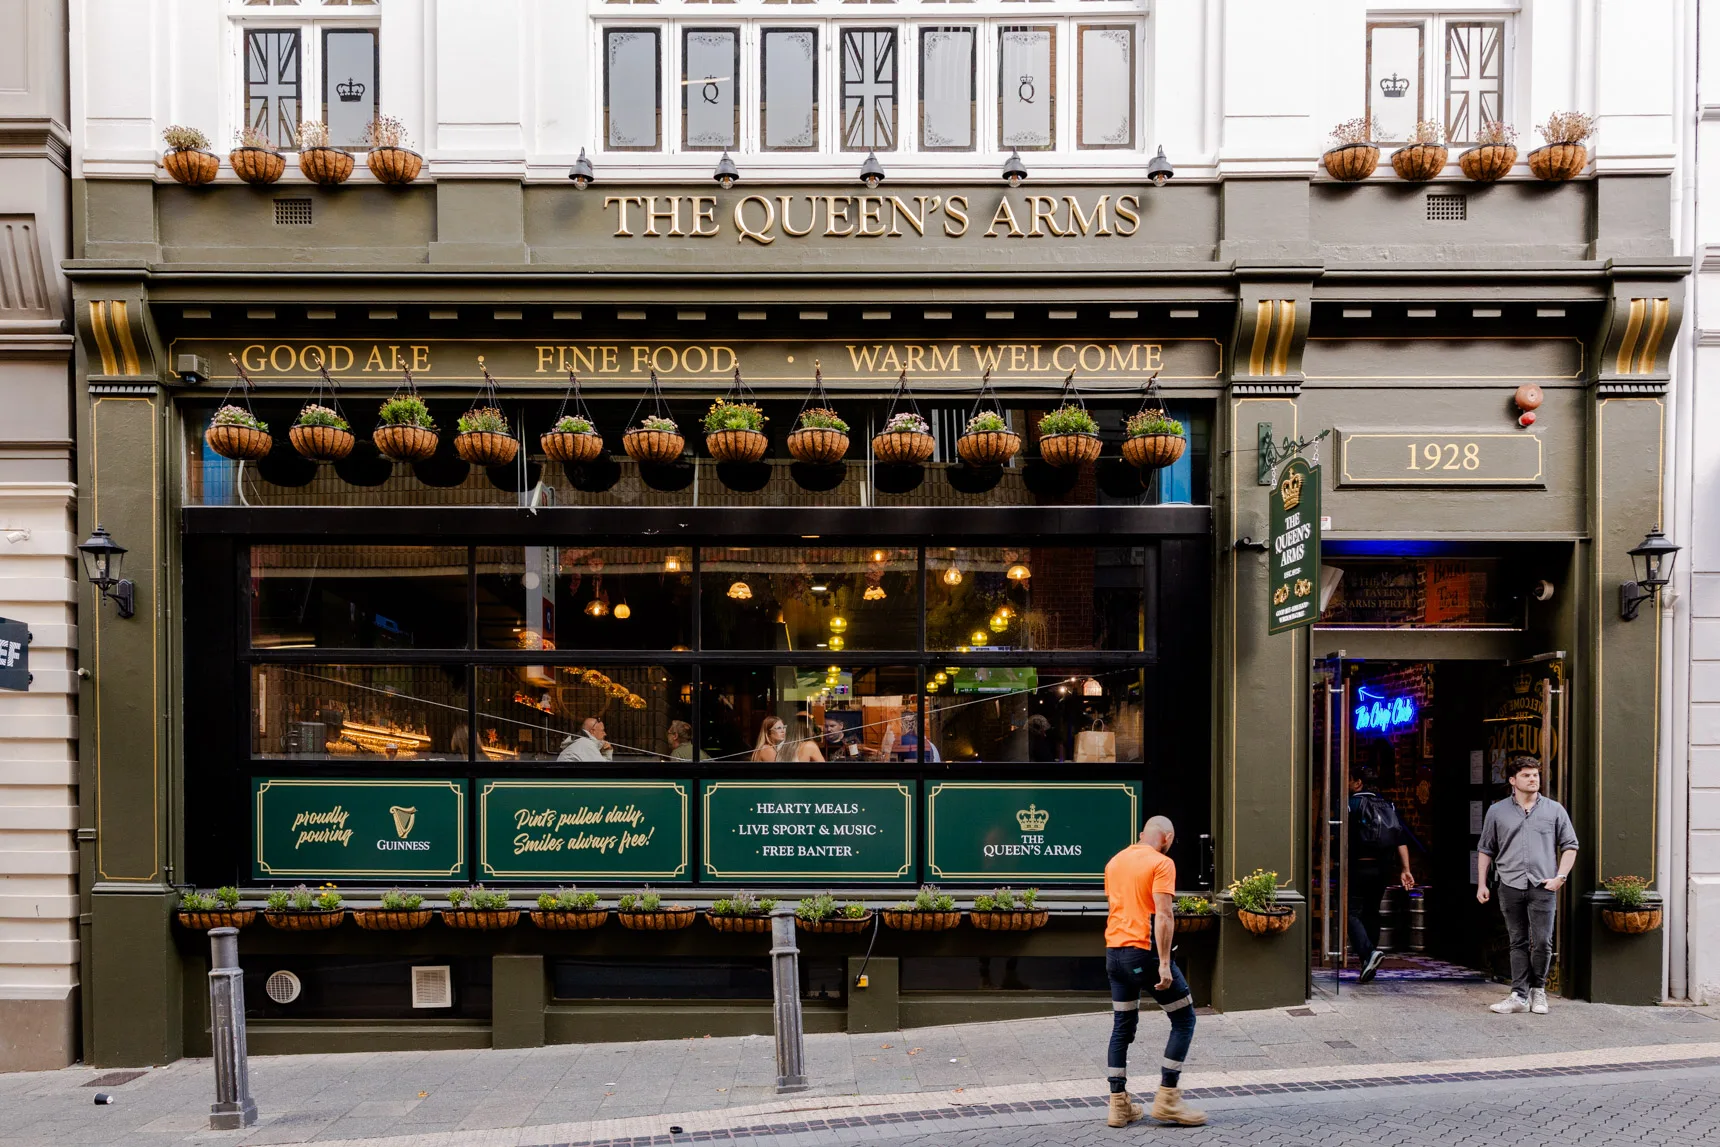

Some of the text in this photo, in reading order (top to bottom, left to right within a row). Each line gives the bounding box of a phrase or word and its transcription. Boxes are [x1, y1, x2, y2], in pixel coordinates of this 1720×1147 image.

[703, 84, 719, 104] Q
[1019, 83, 1035, 104] Q
[604, 194, 1140, 244] THE QUEEN'S ARMS
[242, 344, 431, 372] GOOD ALE
[536, 345, 737, 373] FINE FOOD
[846, 343, 1164, 372] WARM WELCOME
[1406, 443, 1480, 470] 1928
[1284, 512, 1300, 530] THE
[1275, 522, 1311, 554] QUEEN'S
[1280, 543, 1305, 567] ARMS
[1348, 599, 1377, 608] ARMS
[291, 805, 349, 832] proudly
[514, 804, 645, 832] Pints pulled daily,
[756, 803, 858, 814] HEARTY MEALS
[295, 825, 353, 850] pouring
[513, 826, 655, 855] Smiles always free!
[738, 824, 876, 835] LIVE SPORT & MUSIC
[1021, 835, 1044, 844] THE
[376, 839, 430, 850] GUINNESS
[762, 845, 852, 856] FREE BANTER
[983, 844, 1082, 857] QUEEN'S ARMS
